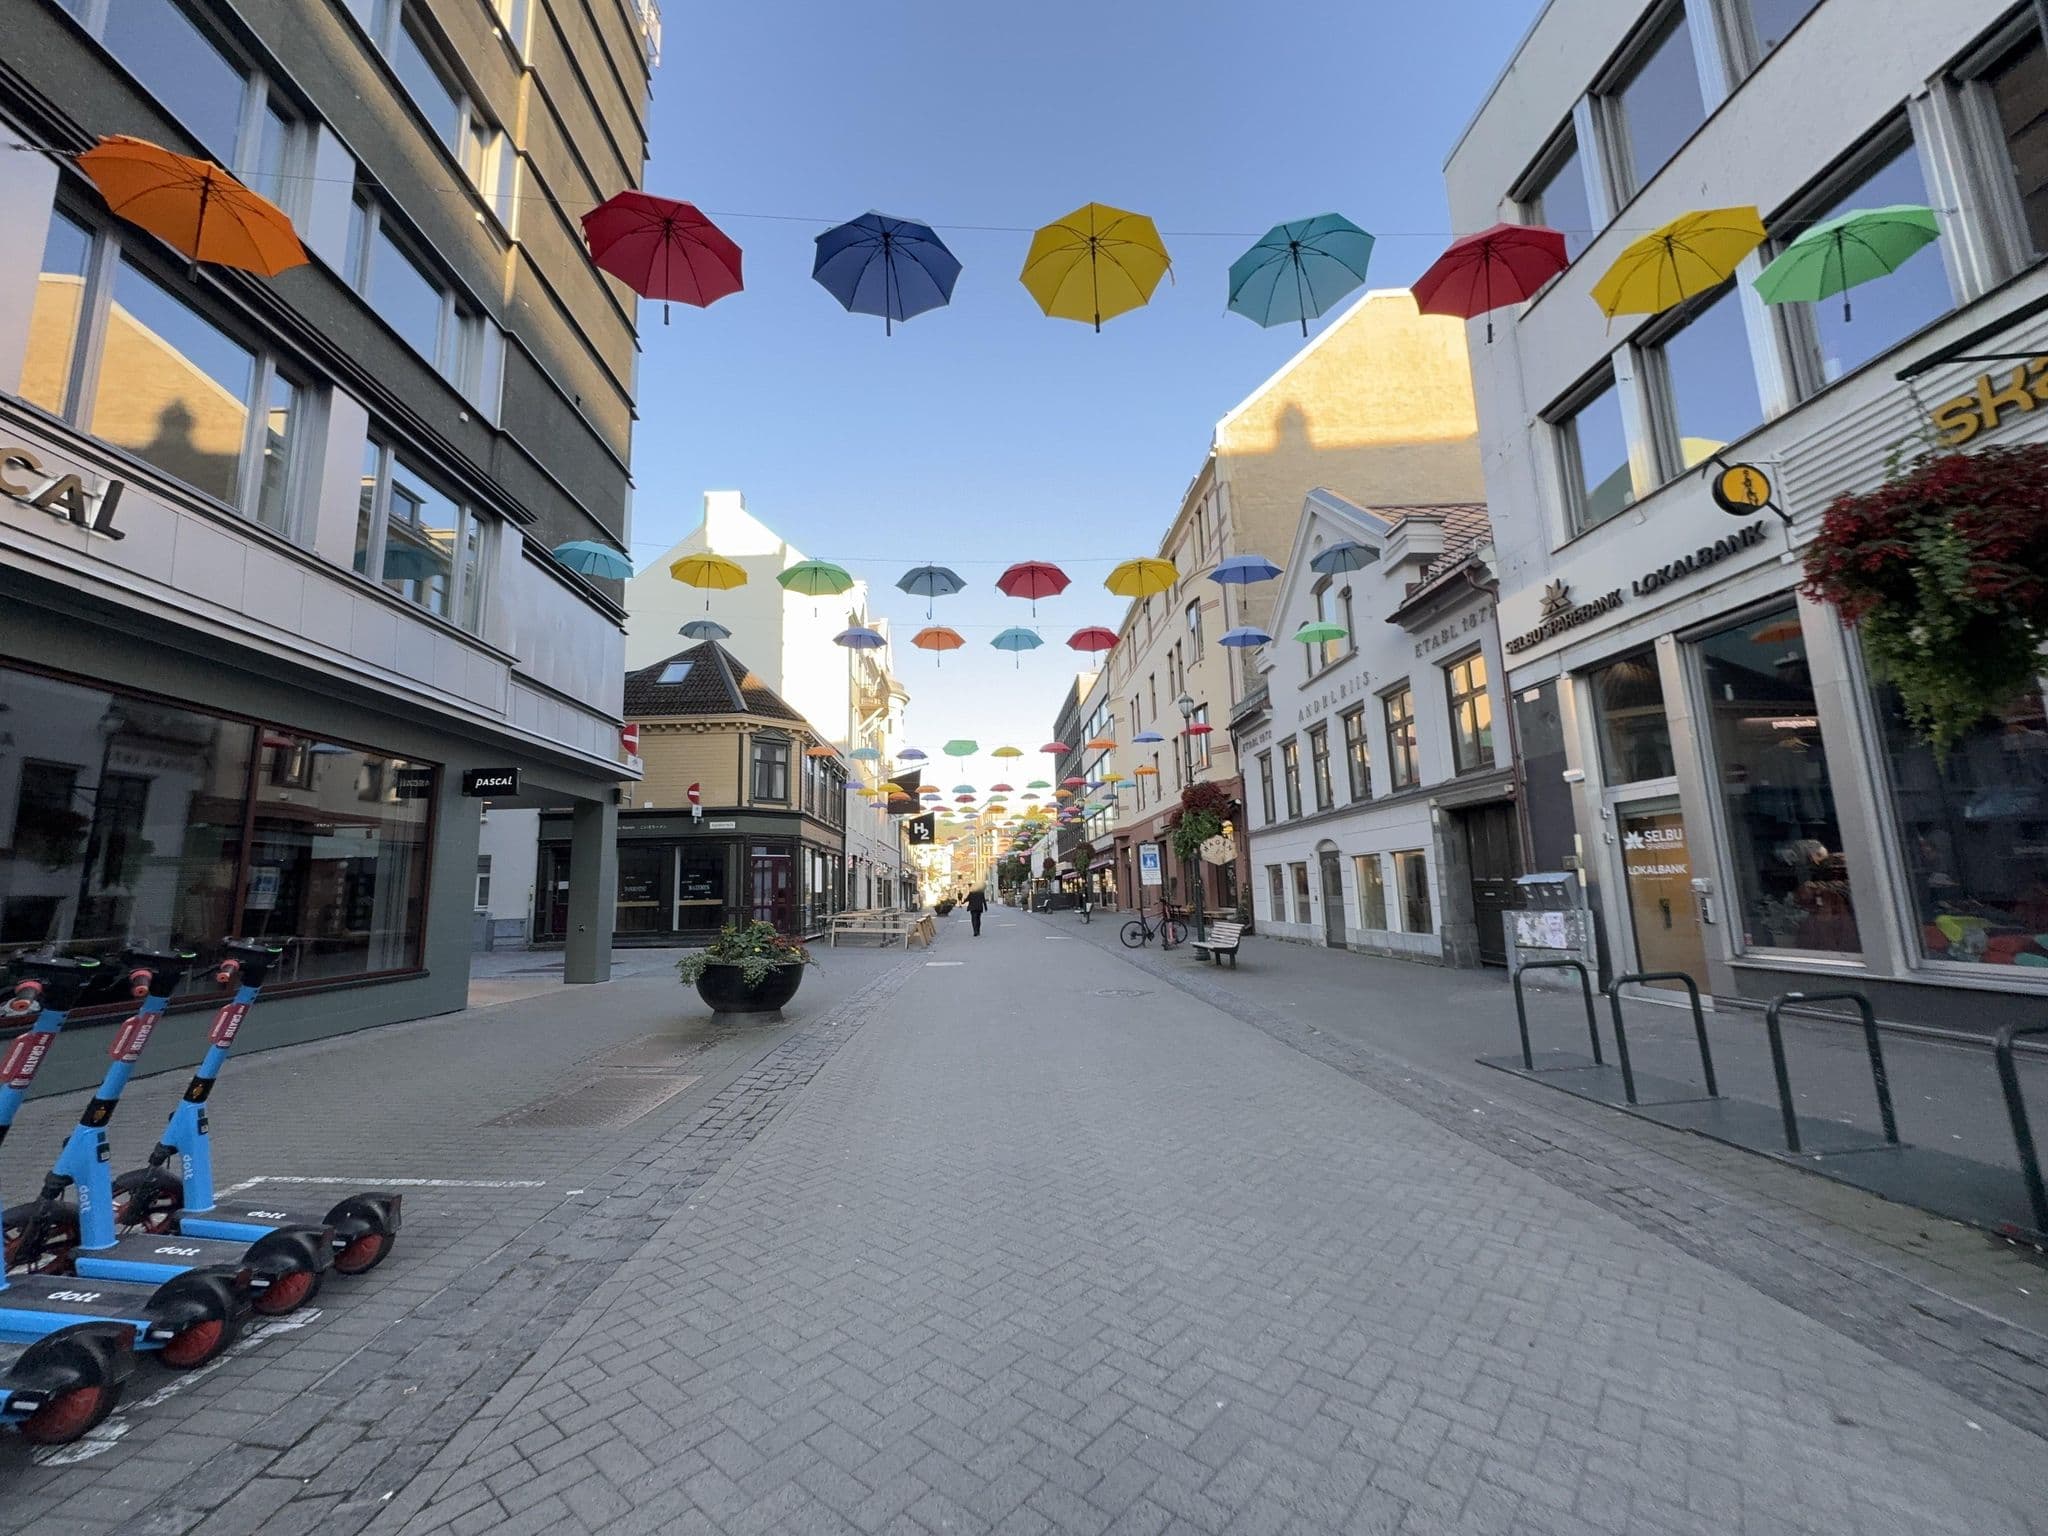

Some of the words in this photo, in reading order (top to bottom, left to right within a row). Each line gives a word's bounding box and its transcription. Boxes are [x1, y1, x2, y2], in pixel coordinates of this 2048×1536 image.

[1504, 622, 1544, 655] SELBU
[1543, 588, 1624, 640] SPAREBANK
[1632, 519, 1768, 597] LOKALBANK
[913, 822, 930, 840] H2
[1643, 828, 1683, 842] SELBU
[1627, 863, 1688, 875] LOKALBANK
[182, 1153, 194, 1180] dott
[79, 1184, 91, 1213] dott
[247, 1210, 288, 1220] dott
[154, 1246, 201, 1257] dott
[47, 1290, 101, 1303] dott
